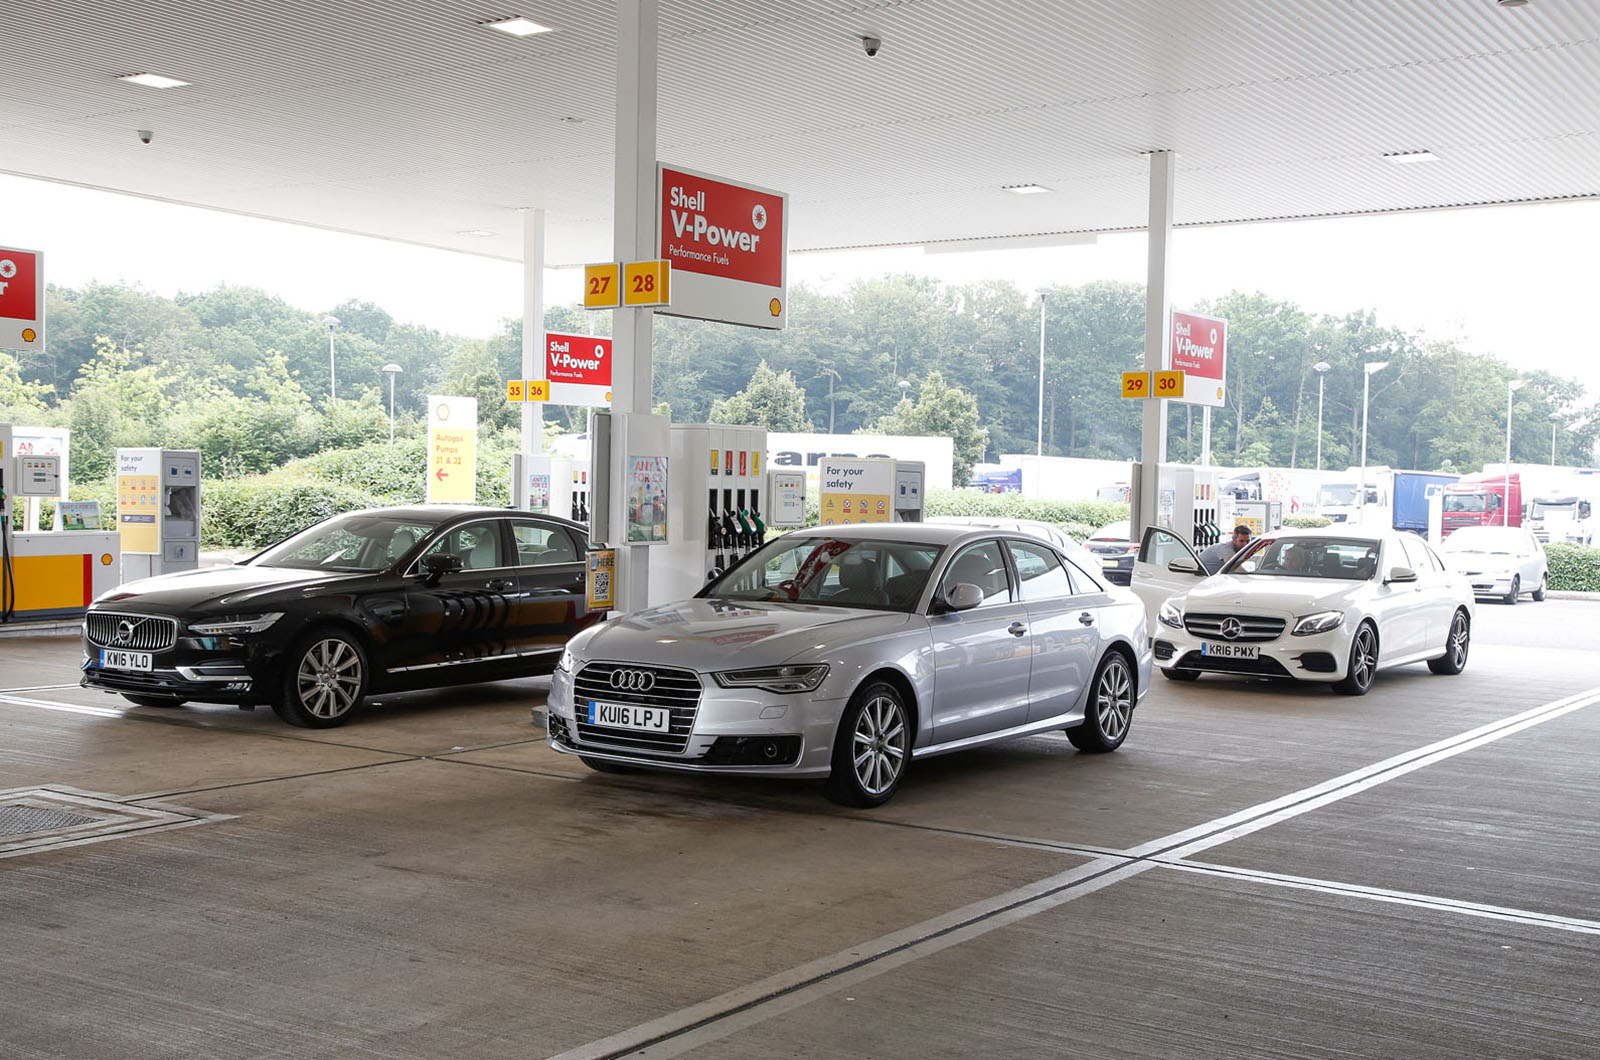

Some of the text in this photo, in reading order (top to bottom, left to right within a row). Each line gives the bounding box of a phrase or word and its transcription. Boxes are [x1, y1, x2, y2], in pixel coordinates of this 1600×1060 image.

[670, 186, 705, 212] Shell
[670, 209, 759, 253] V-Power
[669, 244, 729, 265] Performance Fuels
[589, 276, 611, 295] 27
[633, 274, 655, 293] 28
[1176, 322, 1191, 336] Shell
[550, 341, 570, 353] Shell
[1176, 337, 1214, 359] V-Power
[550, 353, 600, 370] V-Power
[1127, 379, 1143, 391] 29
[1159, 378, 1176, 390] 30
[510, 386, 521, 396] 35
[531, 386, 542, 396] 36
[436, 433, 464, 443] Autogas
[436, 445, 458, 455] Pumps
[635, 461, 653, 471] ANY
[826, 466, 864, 477] For your
[634, 473, 649, 482] FOR
[826, 479, 853, 490] safety
[598, 558, 615, 567] HERE
[1210, 644, 1254, 657] KR16 PMX
[107, 651, 148, 668] KW16 YLO
[600, 705, 663, 728] KU16 LPJ
